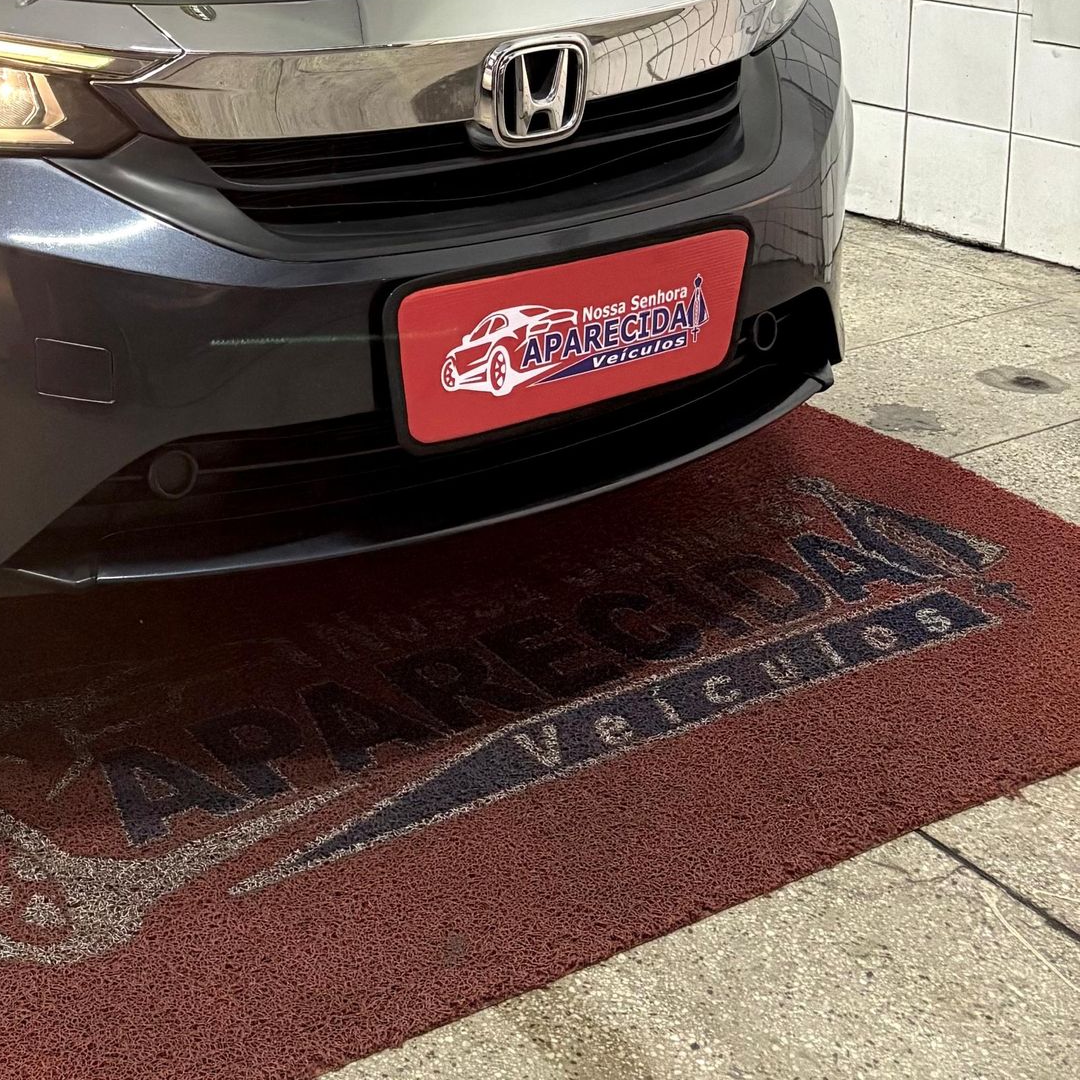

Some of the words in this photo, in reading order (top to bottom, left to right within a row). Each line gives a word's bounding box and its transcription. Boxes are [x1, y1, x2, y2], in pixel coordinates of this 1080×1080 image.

[582, 302, 627, 322] Nossa
[631, 286, 688, 309] Senhora
[521, 302, 690, 369] APARECIDA
[592, 334, 686, 368] Veículos
[107, 530, 928, 845] APARECIDA
